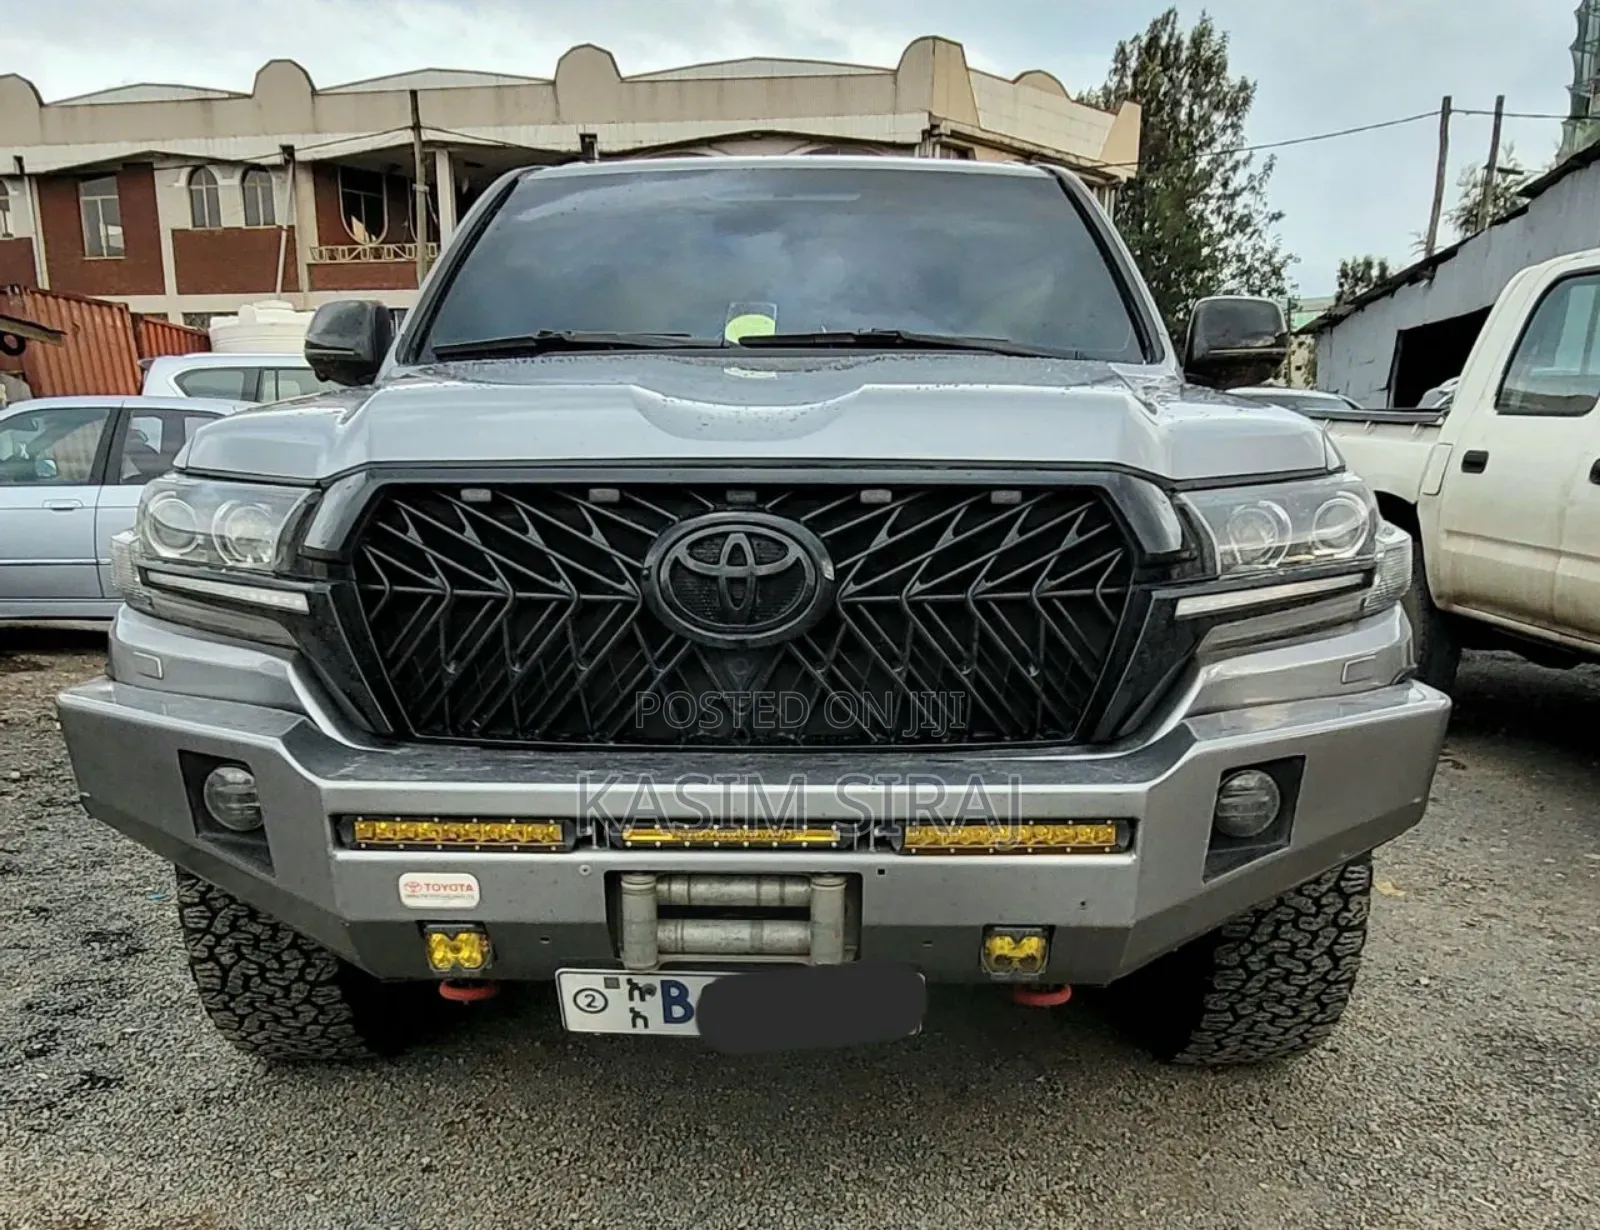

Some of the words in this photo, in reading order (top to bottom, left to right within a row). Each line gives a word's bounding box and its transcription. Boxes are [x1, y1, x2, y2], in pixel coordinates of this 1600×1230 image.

[423, 883, 475, 893] TOYOTA
[583, 993, 598, 1009] 2
[660, 979, 695, 1025] B
